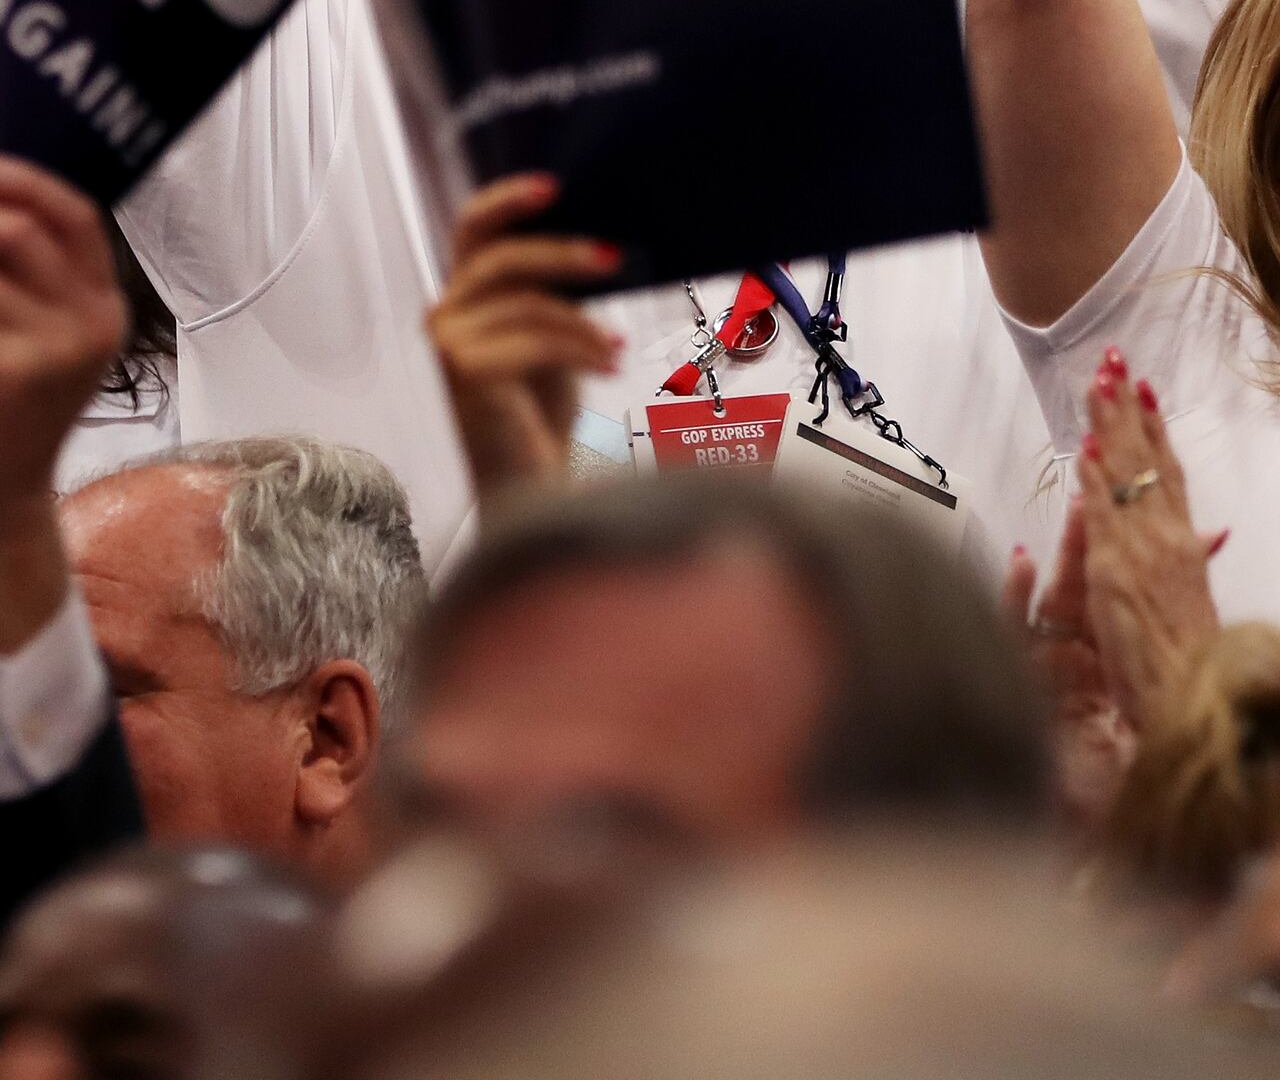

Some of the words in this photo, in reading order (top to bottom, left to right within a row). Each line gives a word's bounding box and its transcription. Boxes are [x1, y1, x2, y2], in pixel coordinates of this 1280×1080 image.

[681, 430, 708, 445] GOP
[712, 424, 766, 443] EXPRESS
[695, 443, 760, 467] RED-33
